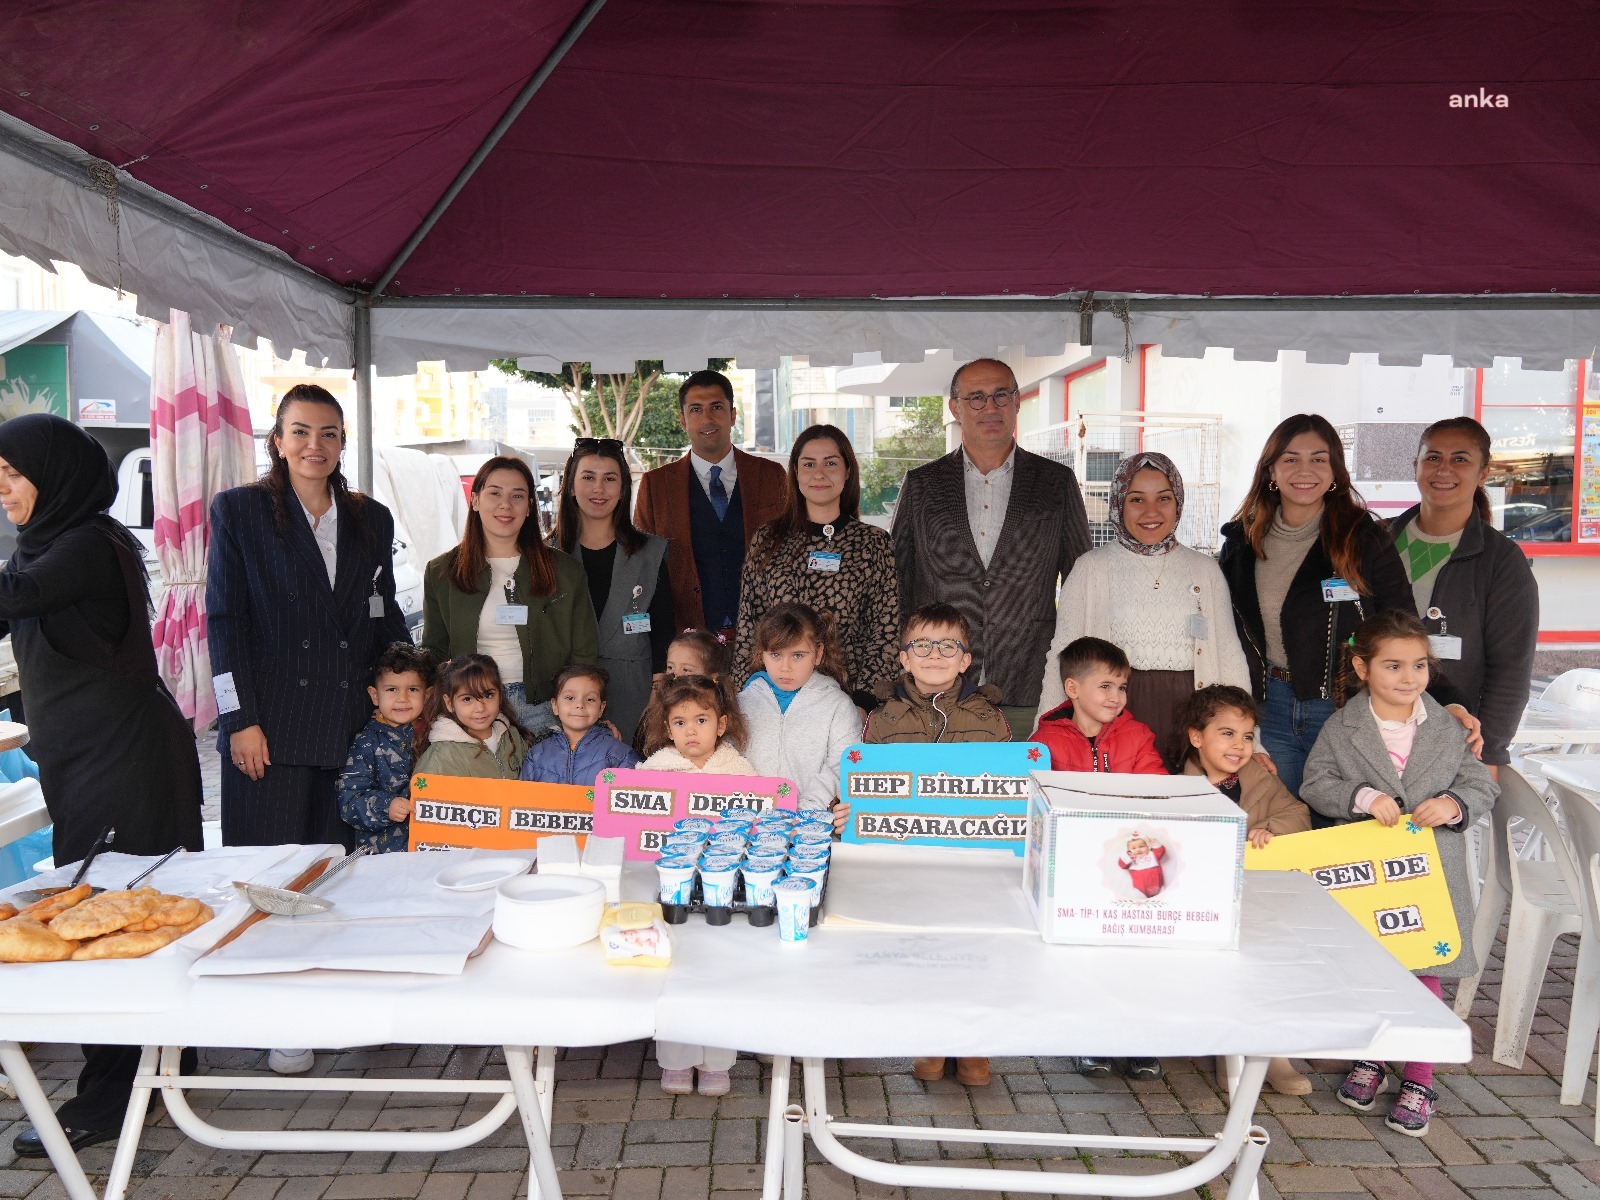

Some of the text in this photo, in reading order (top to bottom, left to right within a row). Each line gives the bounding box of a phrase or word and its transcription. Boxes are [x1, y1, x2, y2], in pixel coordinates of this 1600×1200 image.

[852, 773, 1029, 795] HEP BİRLİKT
[614, 792, 669, 811] SMA
[419, 803, 593, 832] BURÇE BEBEK
[1315, 855, 1427, 887] SEN DE
[1102, 909, 1118, 920] KAS
[1121, 910, 1153, 921] HASTASI
[1157, 910, 1182, 924] BURÇE
[1379, 909, 1418, 931] OL
[1102, 923, 1175, 936] BAĞIŞ KUMBARASI
